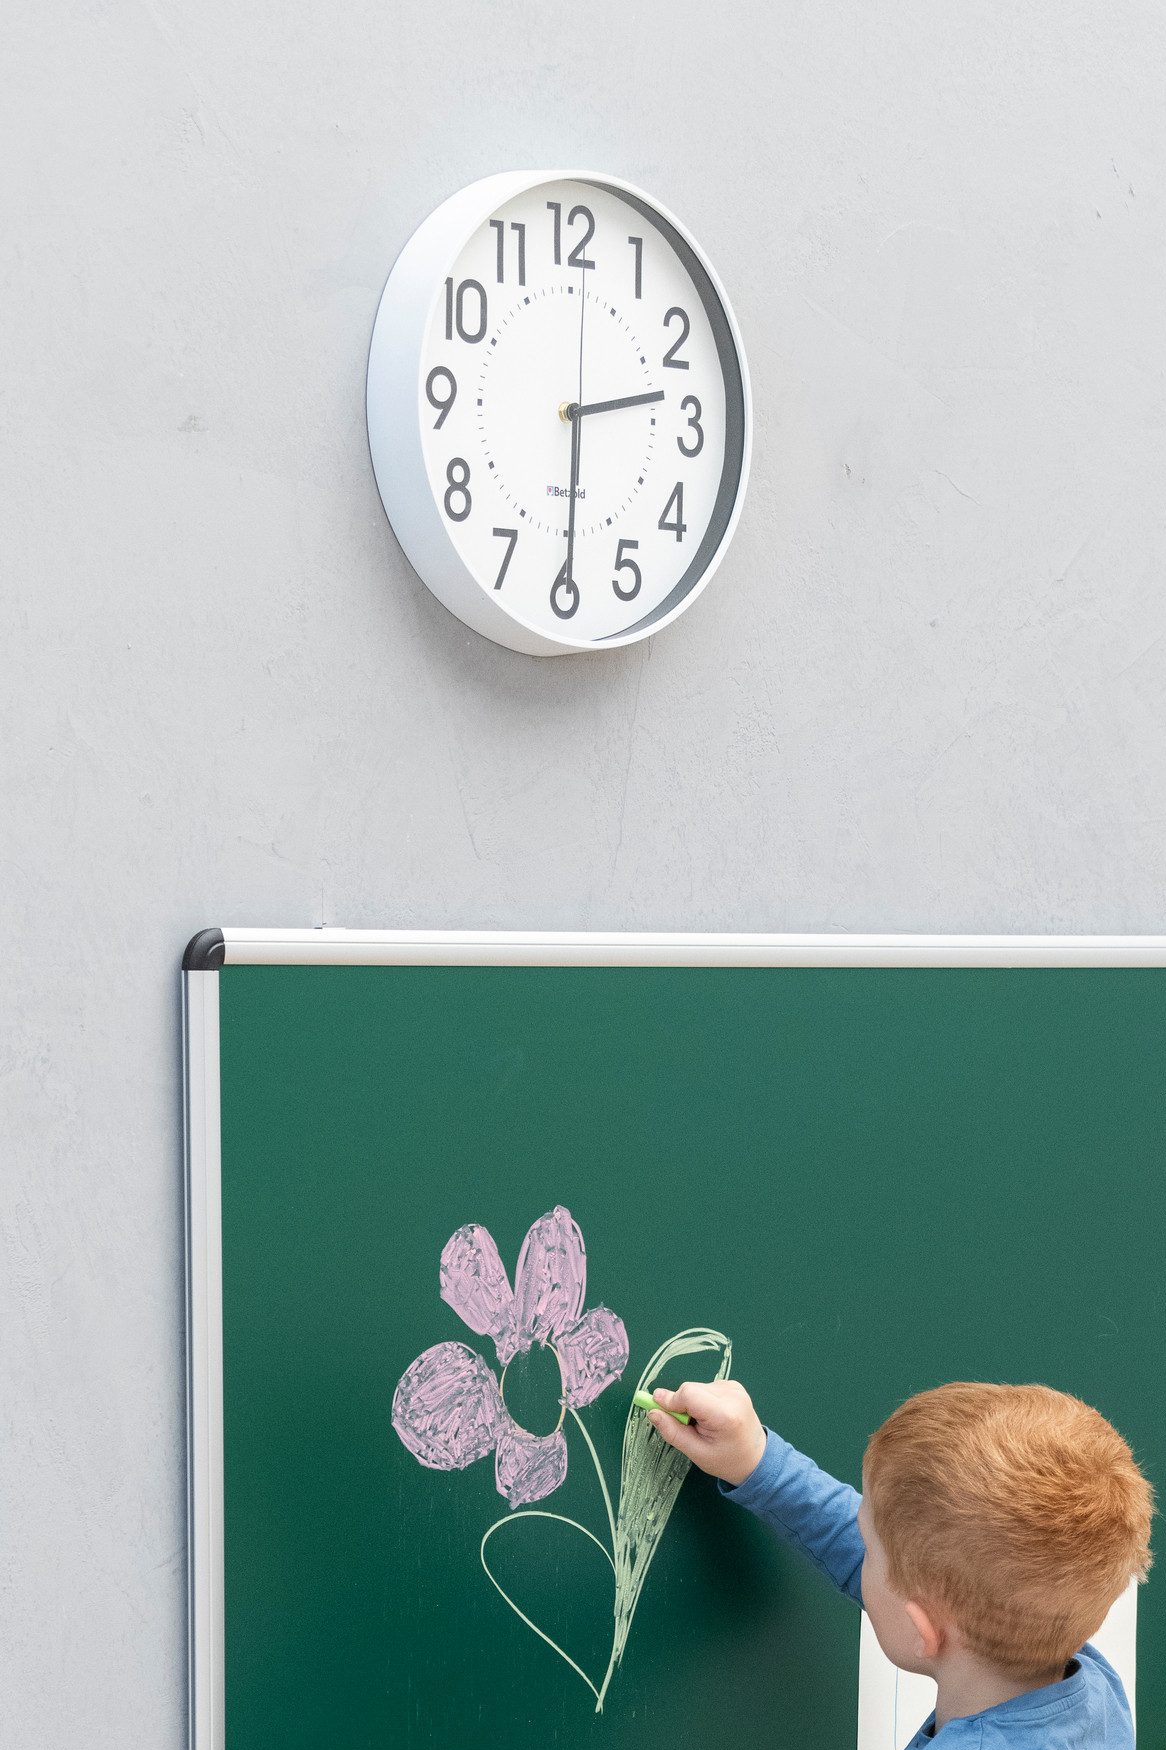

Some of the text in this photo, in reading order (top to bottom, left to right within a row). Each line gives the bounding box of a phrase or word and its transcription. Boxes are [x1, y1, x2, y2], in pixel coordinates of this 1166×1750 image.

[489, 219, 526, 286] 11
[546, 201, 596, 270] 12
[628, 236, 643, 299] 1
[444, 277, 488, 344] 10
[662, 306, 691, 371] 2
[425, 365, 458, 430] 9
[676, 394, 704, 458] 3
[444, 457, 472, 522] 8
[657, 481, 688, 542] 4
[492, 527, 518, 591] 7
[549, 555, 580, 620] 6
[611, 538, 642, 601] 5
